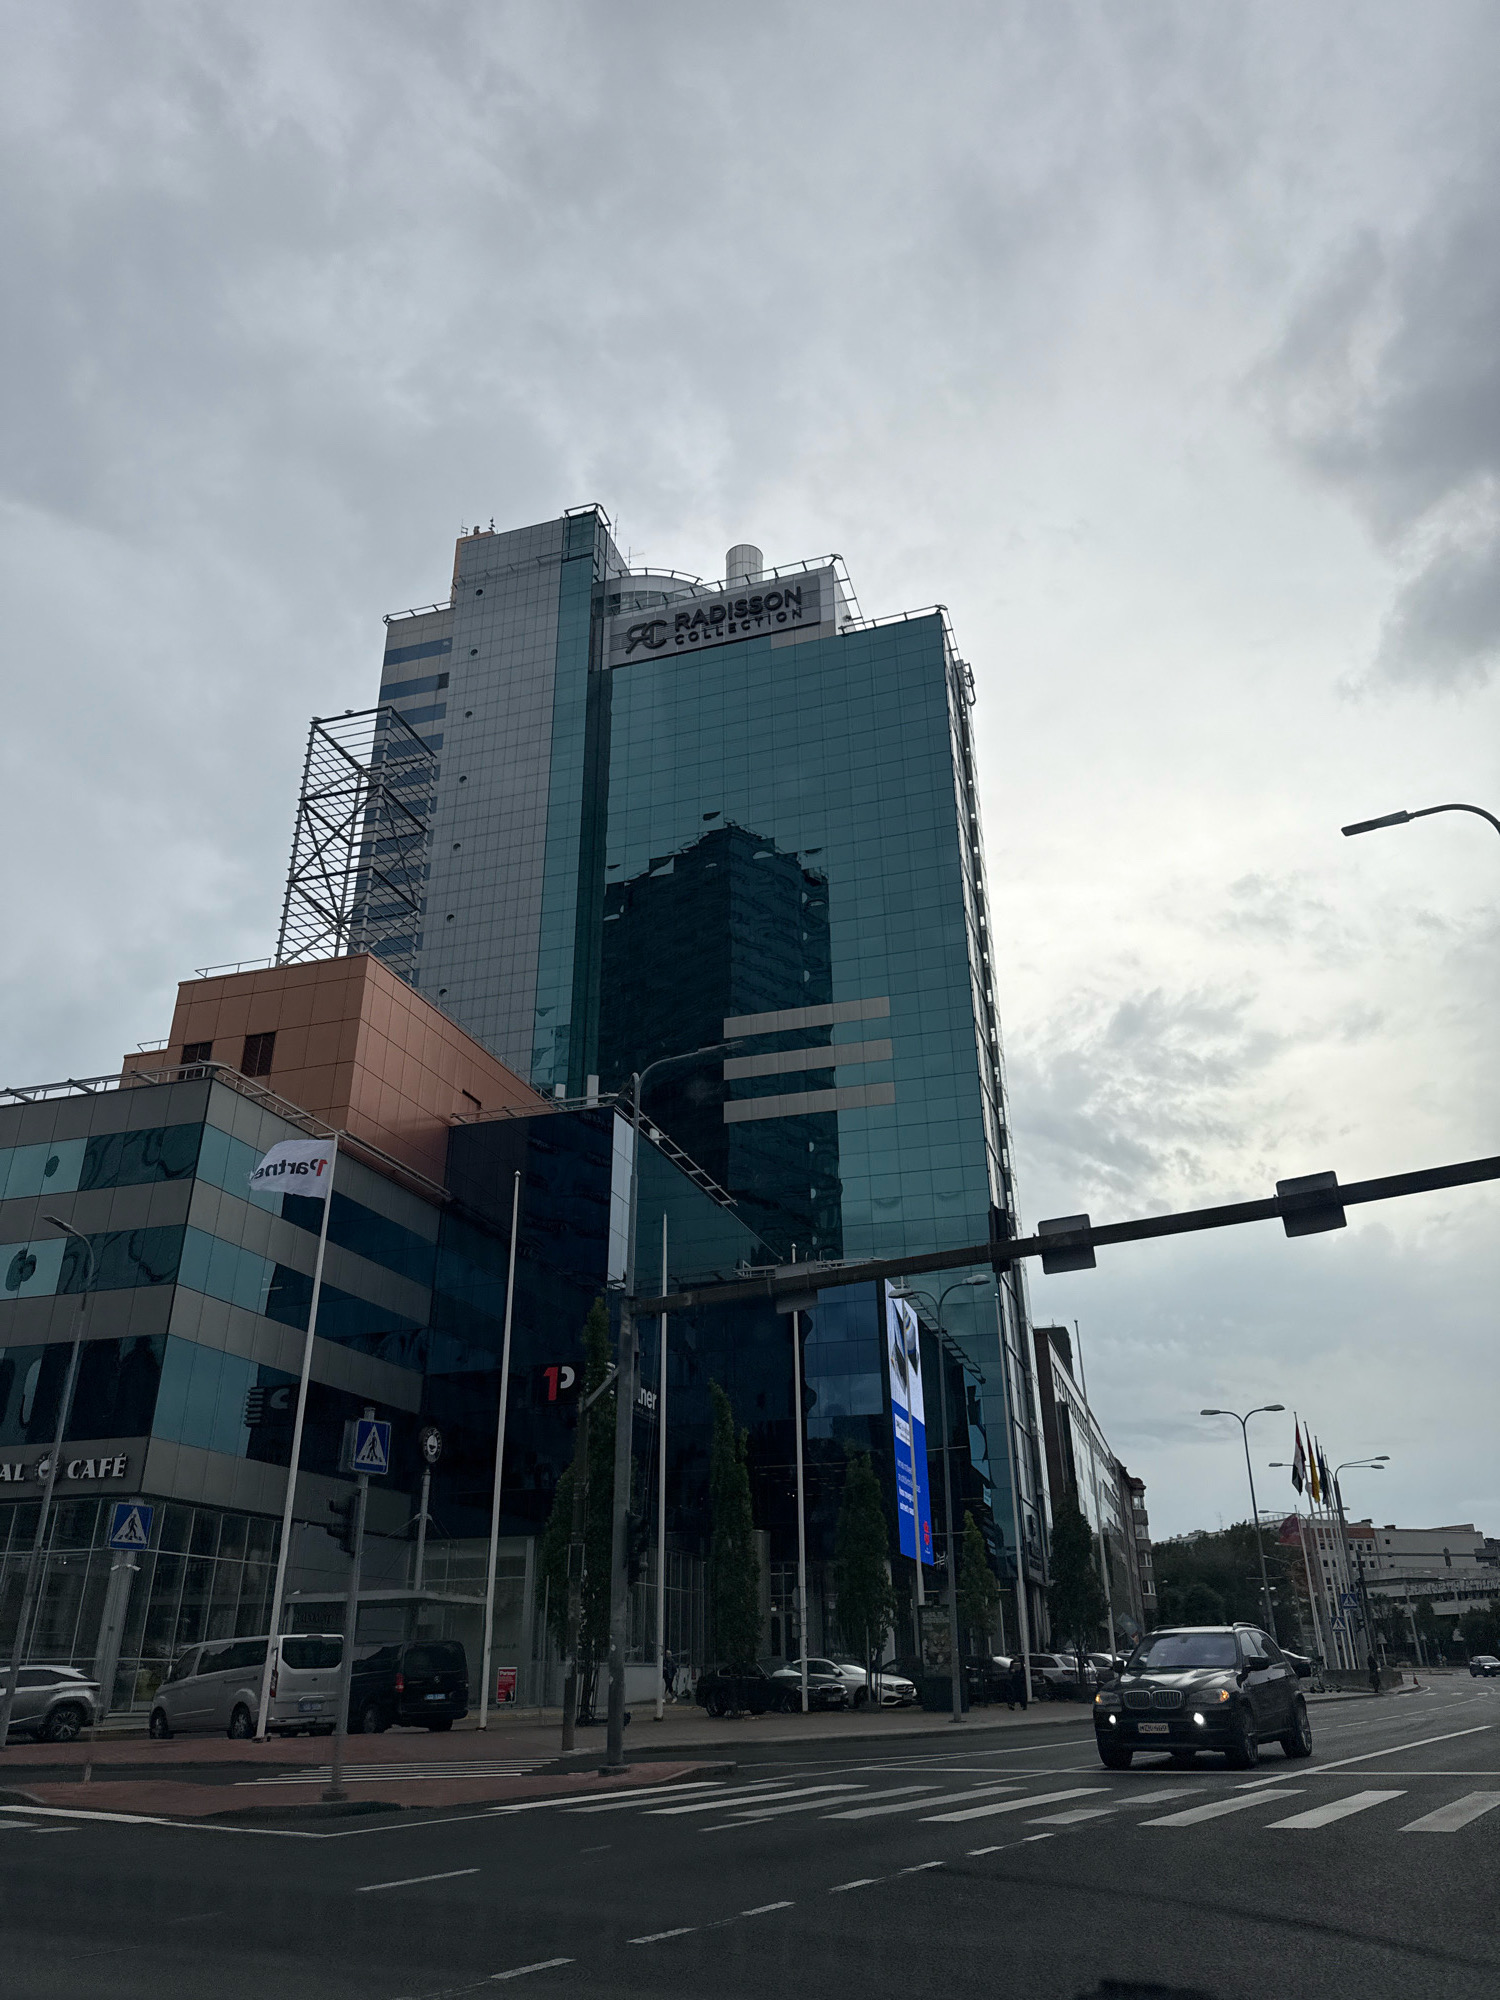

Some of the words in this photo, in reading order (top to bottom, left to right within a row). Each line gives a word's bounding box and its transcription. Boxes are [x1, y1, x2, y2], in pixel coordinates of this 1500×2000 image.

[675, 586, 802, 632] RADISSON
[675, 607, 802, 645] COLLECTION
[67, 1452, 127, 1479] CAFÉ
